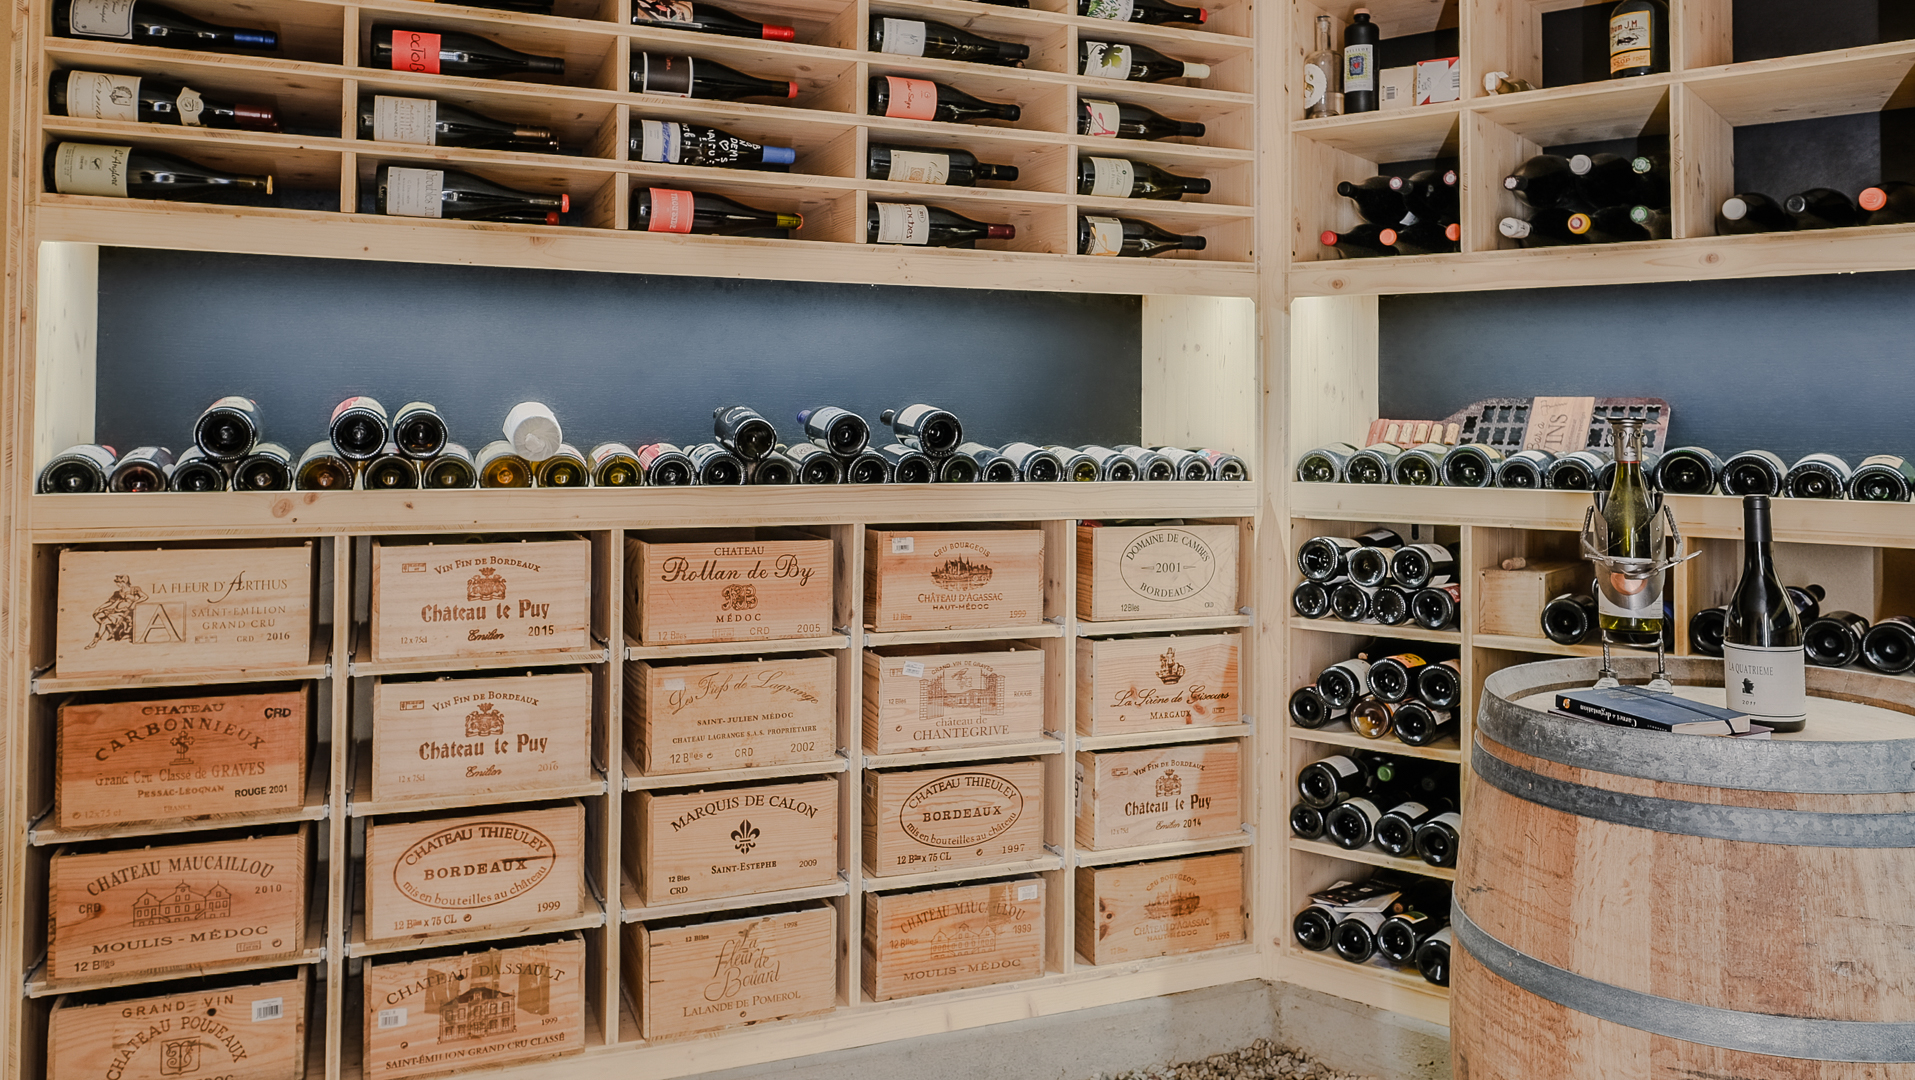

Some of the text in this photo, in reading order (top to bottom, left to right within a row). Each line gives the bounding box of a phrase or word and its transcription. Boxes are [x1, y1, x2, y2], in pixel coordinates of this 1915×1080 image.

[714, 546, 764, 556] CHATEAU
[933, 542, 990, 558] CRU BOURGEOIS
[1126, 533, 1210, 562] DOMAINE DE CAMBES
[434, 564, 453, 574] VIN
[456, 558, 472, 569] FIN
[490, 556, 541, 572] BORDEAUX
[661, 554, 815, 586] Rollan de By
[1156, 562, 1181, 573] 2001
[152, 581, 209, 594] LA FLEUR
[1140, 582, 1194, 598] BORDEAUX
[918, 592, 1003, 603] CHÂTEAU D'AGASSAC
[192, 606, 286, 617] SAINT-EMILION
[518, 599, 550, 619] Puy
[1009, 610, 1026, 618] 1999
[202, 619, 275, 630] GRAND CRU
[716, 614, 762, 623] MÉDOC
[267, 632, 290, 641] 2016
[528, 625, 554, 636] 2015
[658, 624, 820, 640] 12 CRD 2005
[931, 663, 951, 675] GRAND
[973, 661, 993, 672] GRAVES
[1728, 662, 1774, 676] LA QUATRIEME
[751, 670, 819, 704] Lagrange
[432, 700, 451, 711] VIN
[453, 695, 470, 704] FIN
[488, 691, 539, 706] BORDEAUX
[1171, 691, 1182, 703] de
[142, 703, 225, 715] CHATEAU
[264, 708, 291, 719] CRD
[1150, 710, 1191, 720] MARGAUX
[728, 712, 794, 723] JULIEN MÉDOC
[936, 716, 987, 726] château de
[95, 718, 266, 761] CARBONNIEUX
[672, 734, 705, 744] CHATEAU
[708, 731, 745, 741] LAGRANGE
[767, 725, 817, 735] PROPRIETAIRE
[913, 725, 1009, 741] CHANTEGRIVE
[517, 734, 548, 753] Puy
[670, 742, 815, 764] 12 CRD 2002
[195, 768, 207, 780] de
[211, 761, 265, 778] GRAVES
[1132, 766, 1147, 776] VIN
[1147, 763, 1159, 771] FIN
[1171, 760, 1205, 771] BORDEAUX
[234, 784, 288, 797] ROUGE 2001
[908, 776, 1017, 809] CHATEAU THIEULEY
[1190, 794, 1212, 810] Puy
[670, 795, 818, 832] MARQUIS DE CALON
[923, 805, 1002, 822] BORDEAUX
[907, 812, 1017, 845] mis en bouteilles au château
[1183, 818, 1201, 828] 2014
[405, 827, 548, 866] CHATEAU THIEULEY
[1002, 844, 1025, 854] 1997
[897, 855, 906, 865] 12
[929, 851, 938, 861] 75
[940, 850, 951, 861] CL
[424, 859, 528, 880] BORDEAUX
[711, 859, 817, 875] SAINT-ESTEPHE 2009
[87, 856, 274, 896] CHATEAU MAUCAILLOU
[255, 884, 282, 894] 2010
[403, 866, 547, 906] mis en bouteilles château
[670, 886, 688, 895] CRD
[78, 903, 101, 914] CRD
[537, 901, 561, 912] 1999
[394, 920, 404, 930] 12
[431, 916, 442, 926] 75
[443, 914, 457, 924] CL
[900, 905, 950, 934] CHATEAU
[1012, 924, 1032, 934] 1999
[92, 926, 268, 954] MOULIS MÉDOC
[890, 940, 898, 949] 12
[74, 962, 88, 972] 12
[903, 959, 1021, 980] MOULIS MÉDOC
[386, 963, 565, 1005] CHATEAU DASSAULT
[122, 995, 234, 1018] GRAND VIN
[683, 990, 800, 1017] LALANDE DE POMEROL
[541, 1017, 558, 1026] 1999
[181, 1017, 247, 1063] POUJEAUX
[385, 1032, 565, 1069] SAINT-ÉMILION GRAND CRU CLASSÉ
